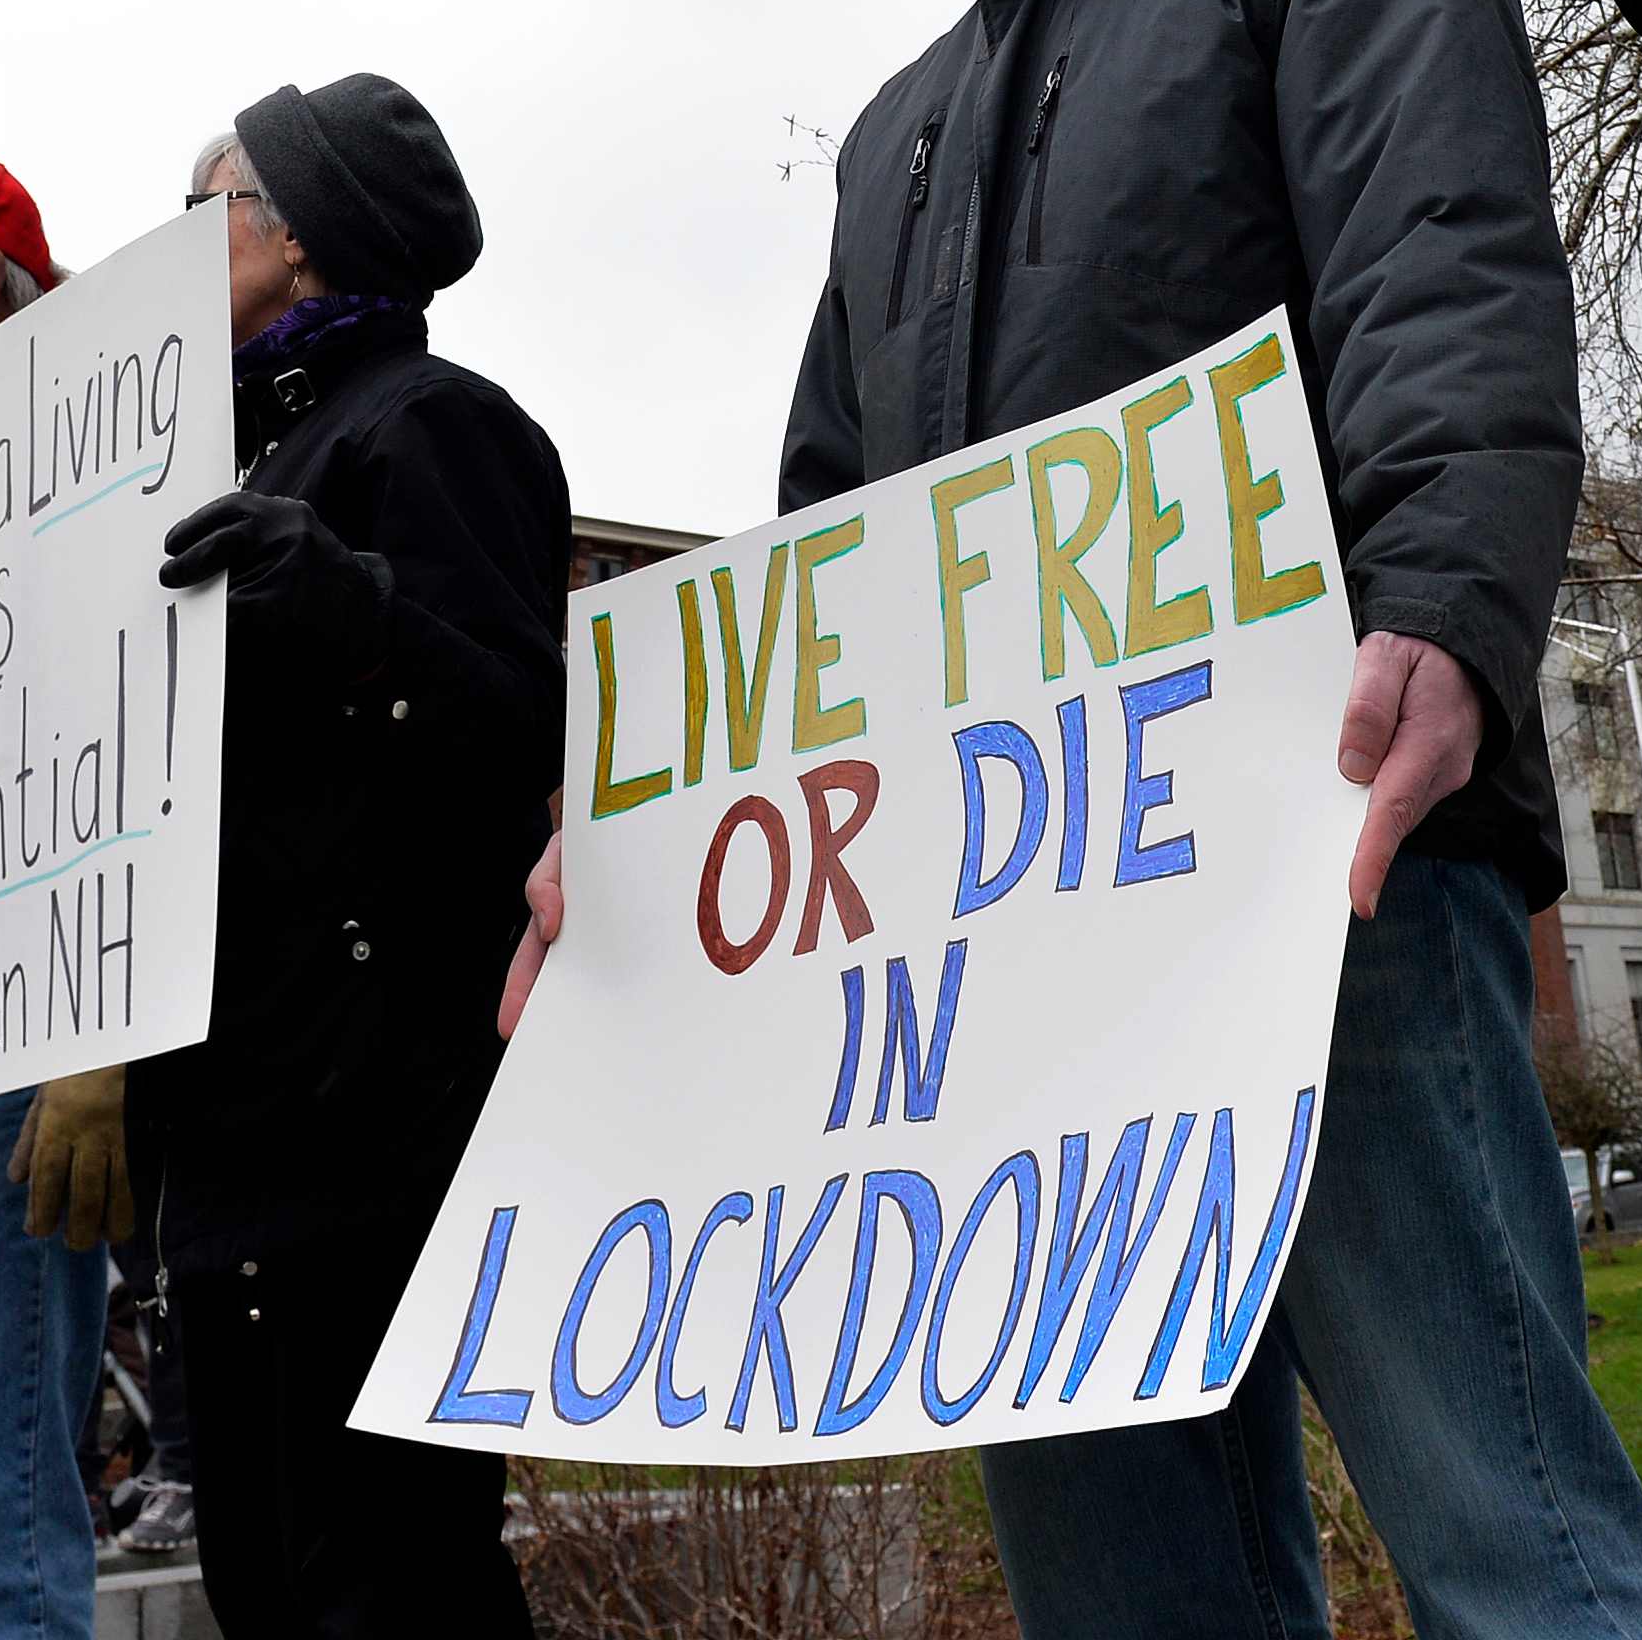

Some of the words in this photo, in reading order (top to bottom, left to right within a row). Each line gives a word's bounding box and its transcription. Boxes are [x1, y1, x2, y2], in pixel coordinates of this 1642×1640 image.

[28, 333, 183, 517] Living
[589, 511, 868, 823] LIVE
[929, 330, 1327, 709] FREE
[695, 758, 881, 976] OR
[951, 658, 1214, 921] DIE
[47, 862, 135, 1041] NH
[822, 937, 969, 1135] IN
[425, 1084, 1317, 1436] LOCKDOWN
